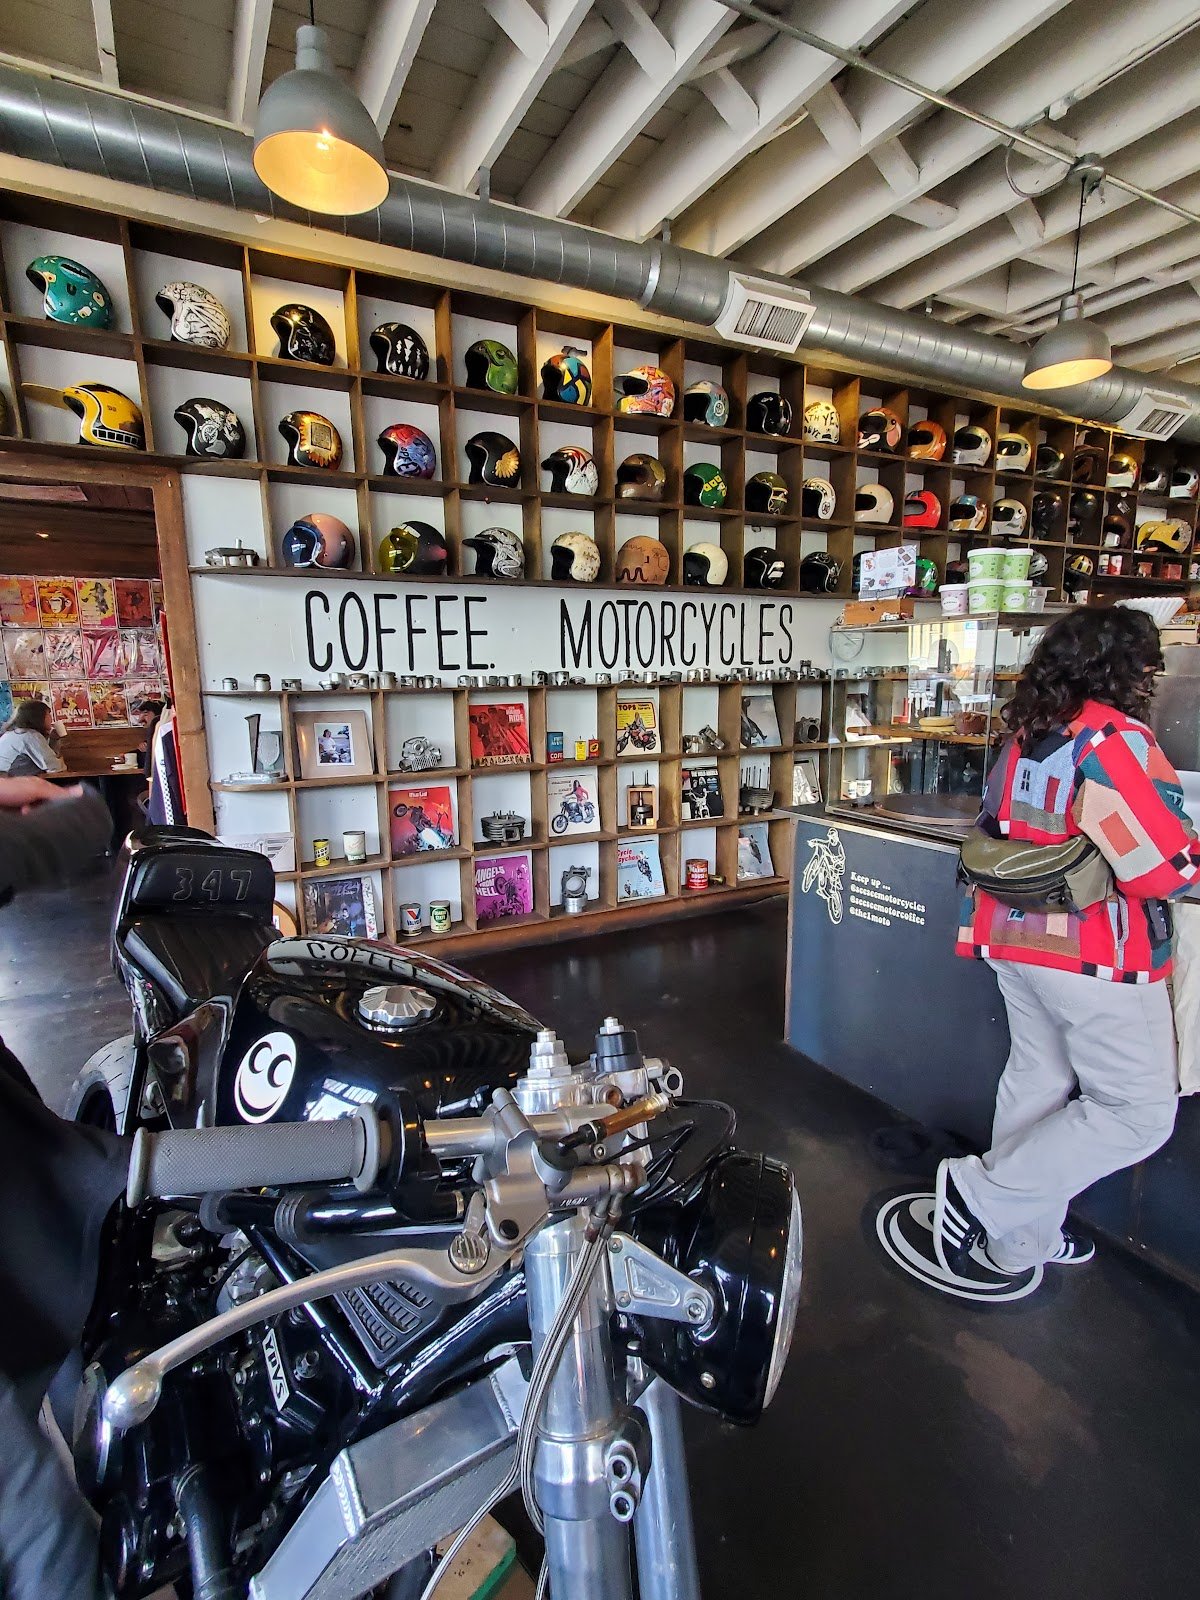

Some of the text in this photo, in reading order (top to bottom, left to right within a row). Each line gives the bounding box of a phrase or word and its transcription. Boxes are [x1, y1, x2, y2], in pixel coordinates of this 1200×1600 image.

[304, 590, 795, 672] COFFEE. MOTORCYCLES
[172, 867, 252, 901] 347
[475, 866, 506, 883] ANGELS
[850, 871, 870, 886] Keep
[871, 878, 881, 889] up
[475, 886, 500, 896] HELL
[850, 883, 926, 913] @seeseemotorcycles
[849, 894, 926, 926] @seeseemotorcoffee
[849, 906, 891, 927] @the1moto
